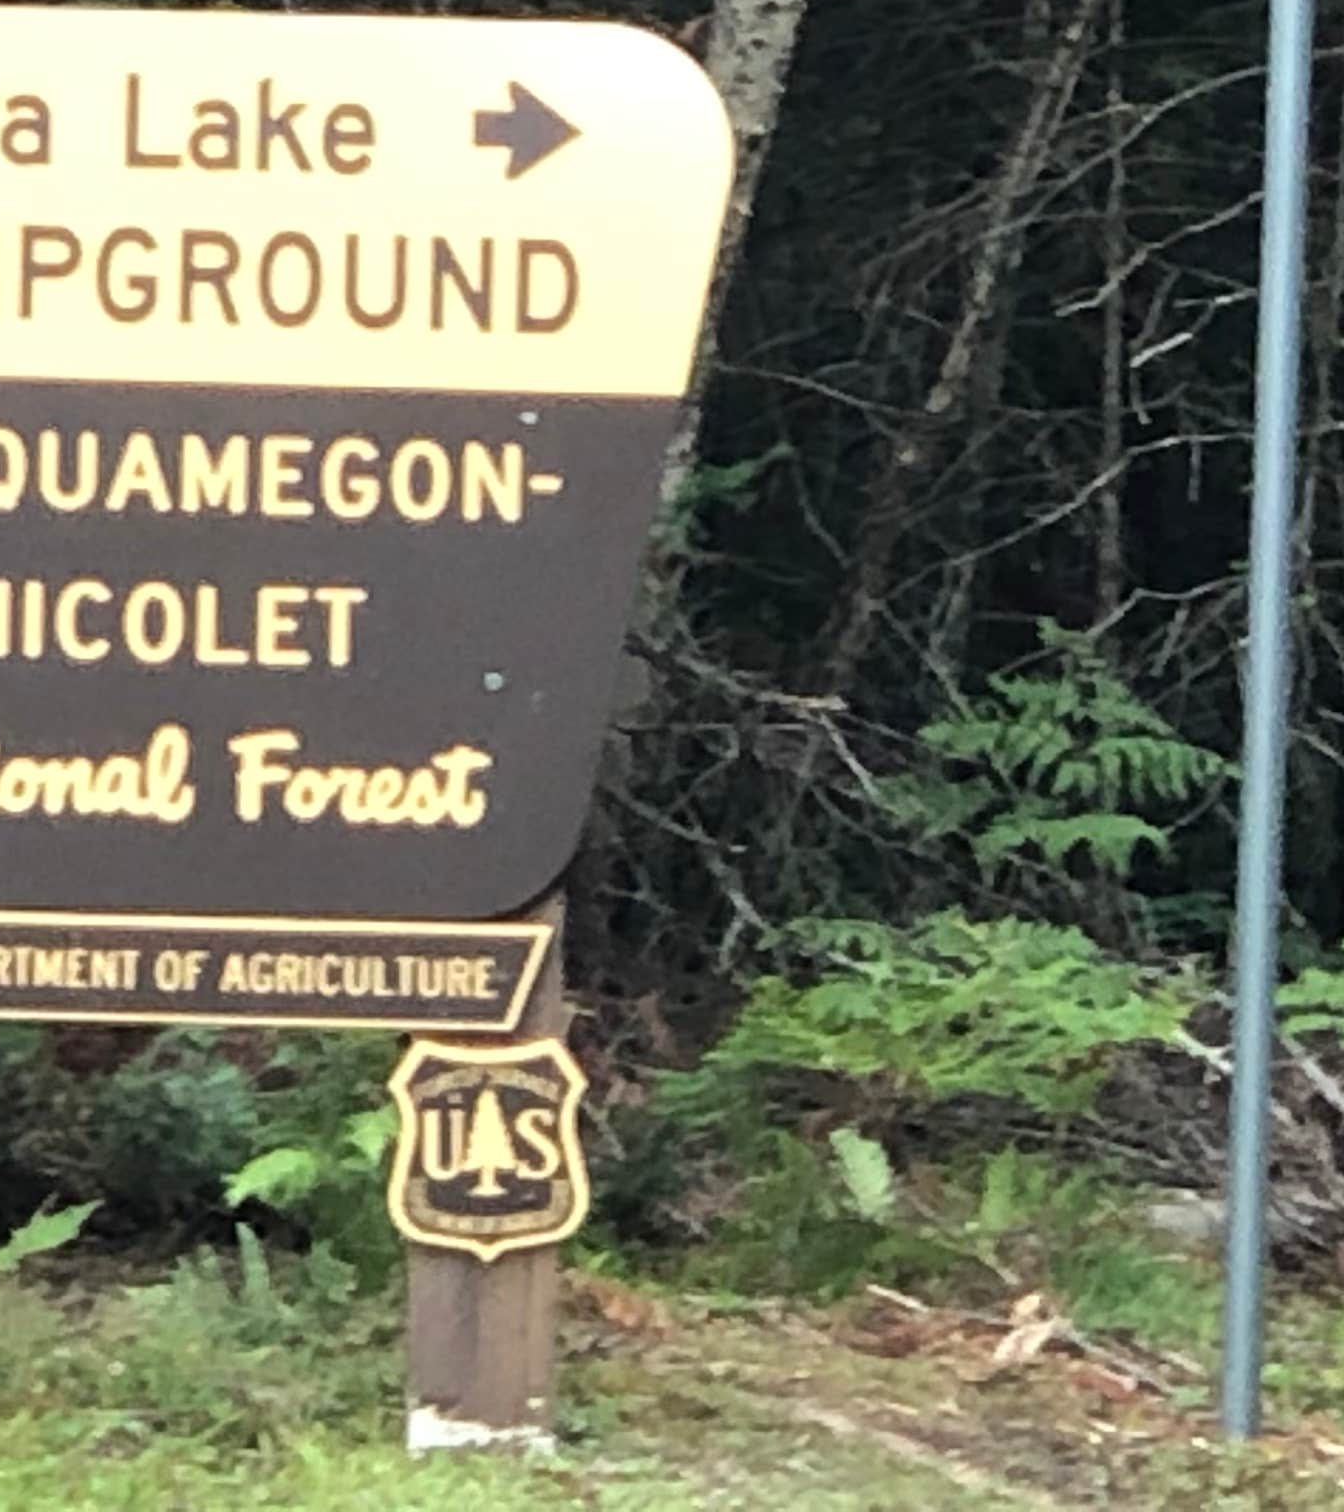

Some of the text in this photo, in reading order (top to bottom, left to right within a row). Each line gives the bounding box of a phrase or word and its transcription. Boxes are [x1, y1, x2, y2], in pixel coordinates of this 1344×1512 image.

[124, 75, 376, 175] Lake
[229, 729, 492, 829] Forest
[155, 949, 209, 992] OF
[219, 952, 499, 1000] AGRICULTURE
